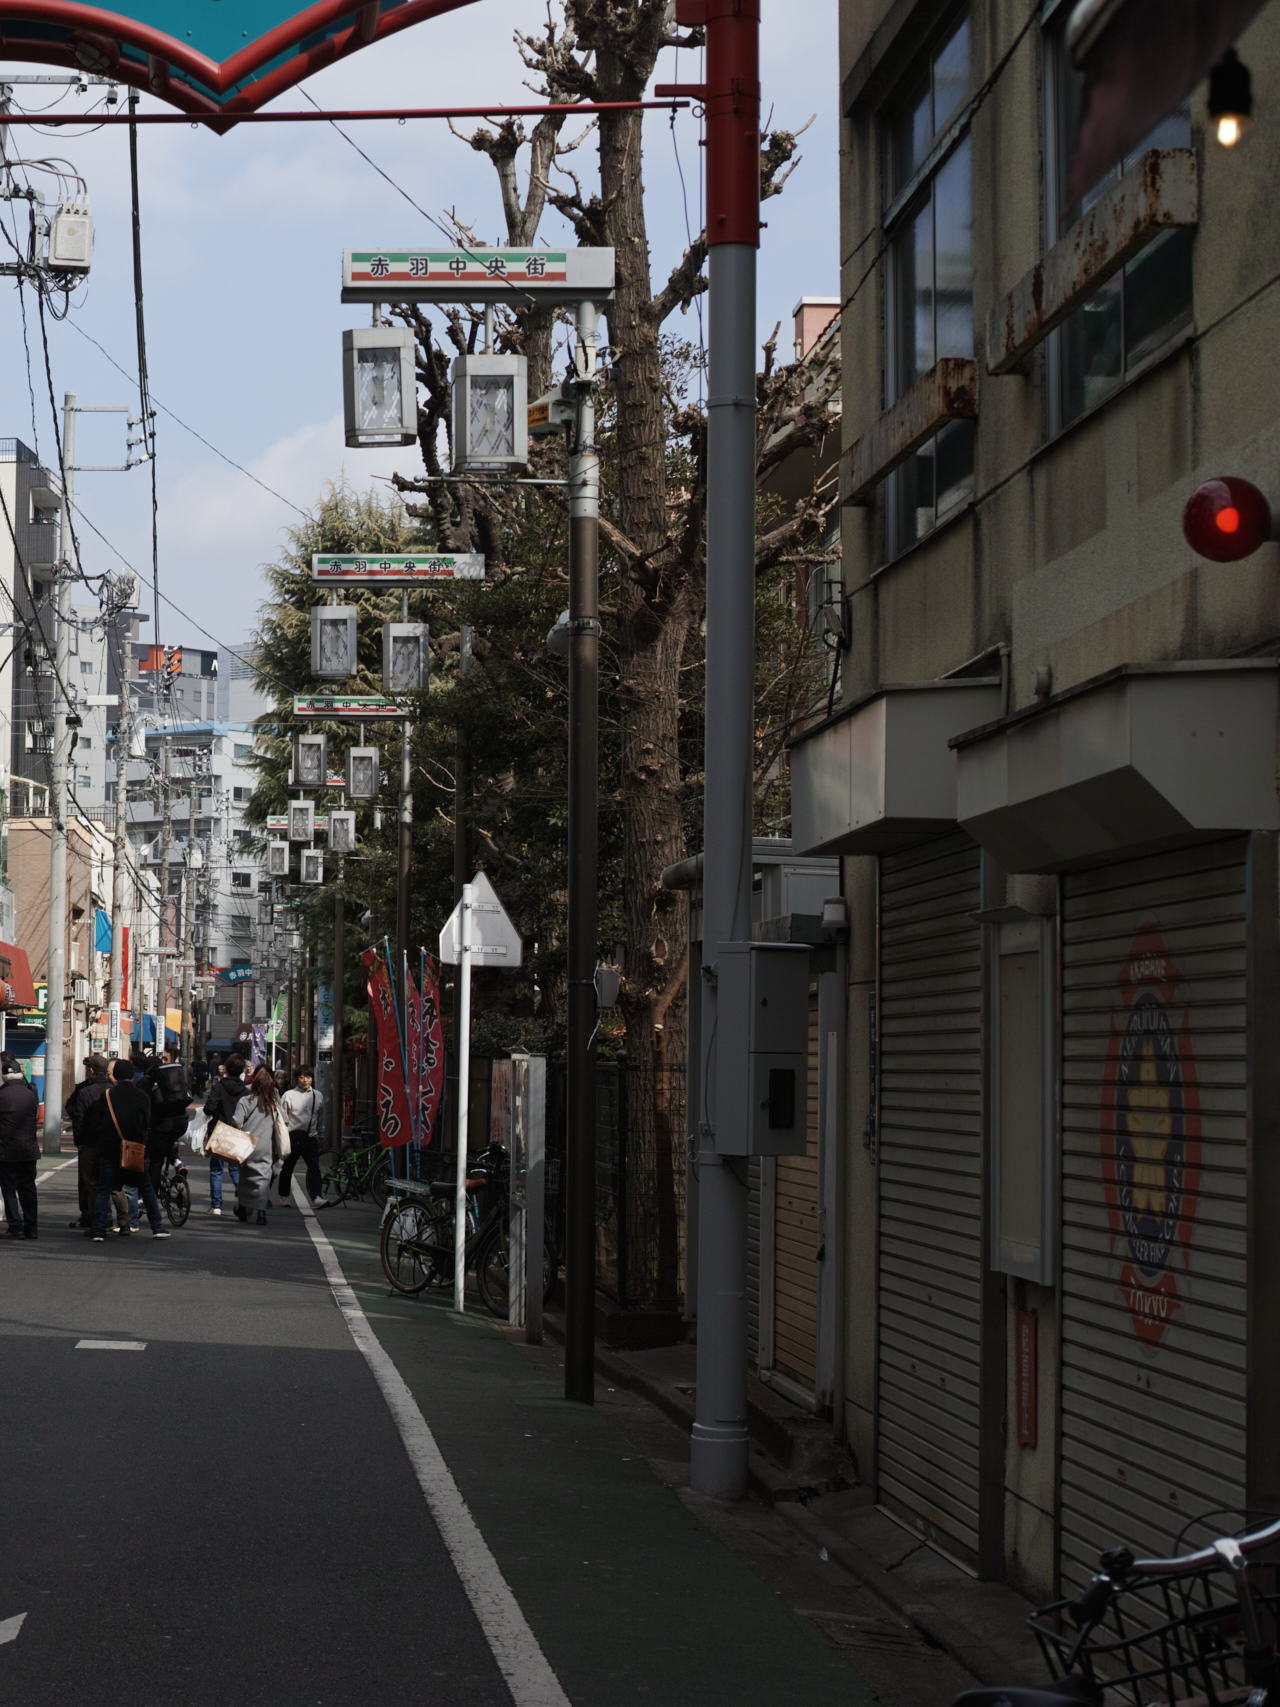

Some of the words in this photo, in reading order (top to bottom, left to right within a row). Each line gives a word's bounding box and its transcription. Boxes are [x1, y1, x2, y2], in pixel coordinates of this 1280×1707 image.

[370, 255, 547, 277] 赤羽中央街
[328, 560, 442, 574] 赤羽中央街
[1130, 952, 1167, 984] AKABANE
